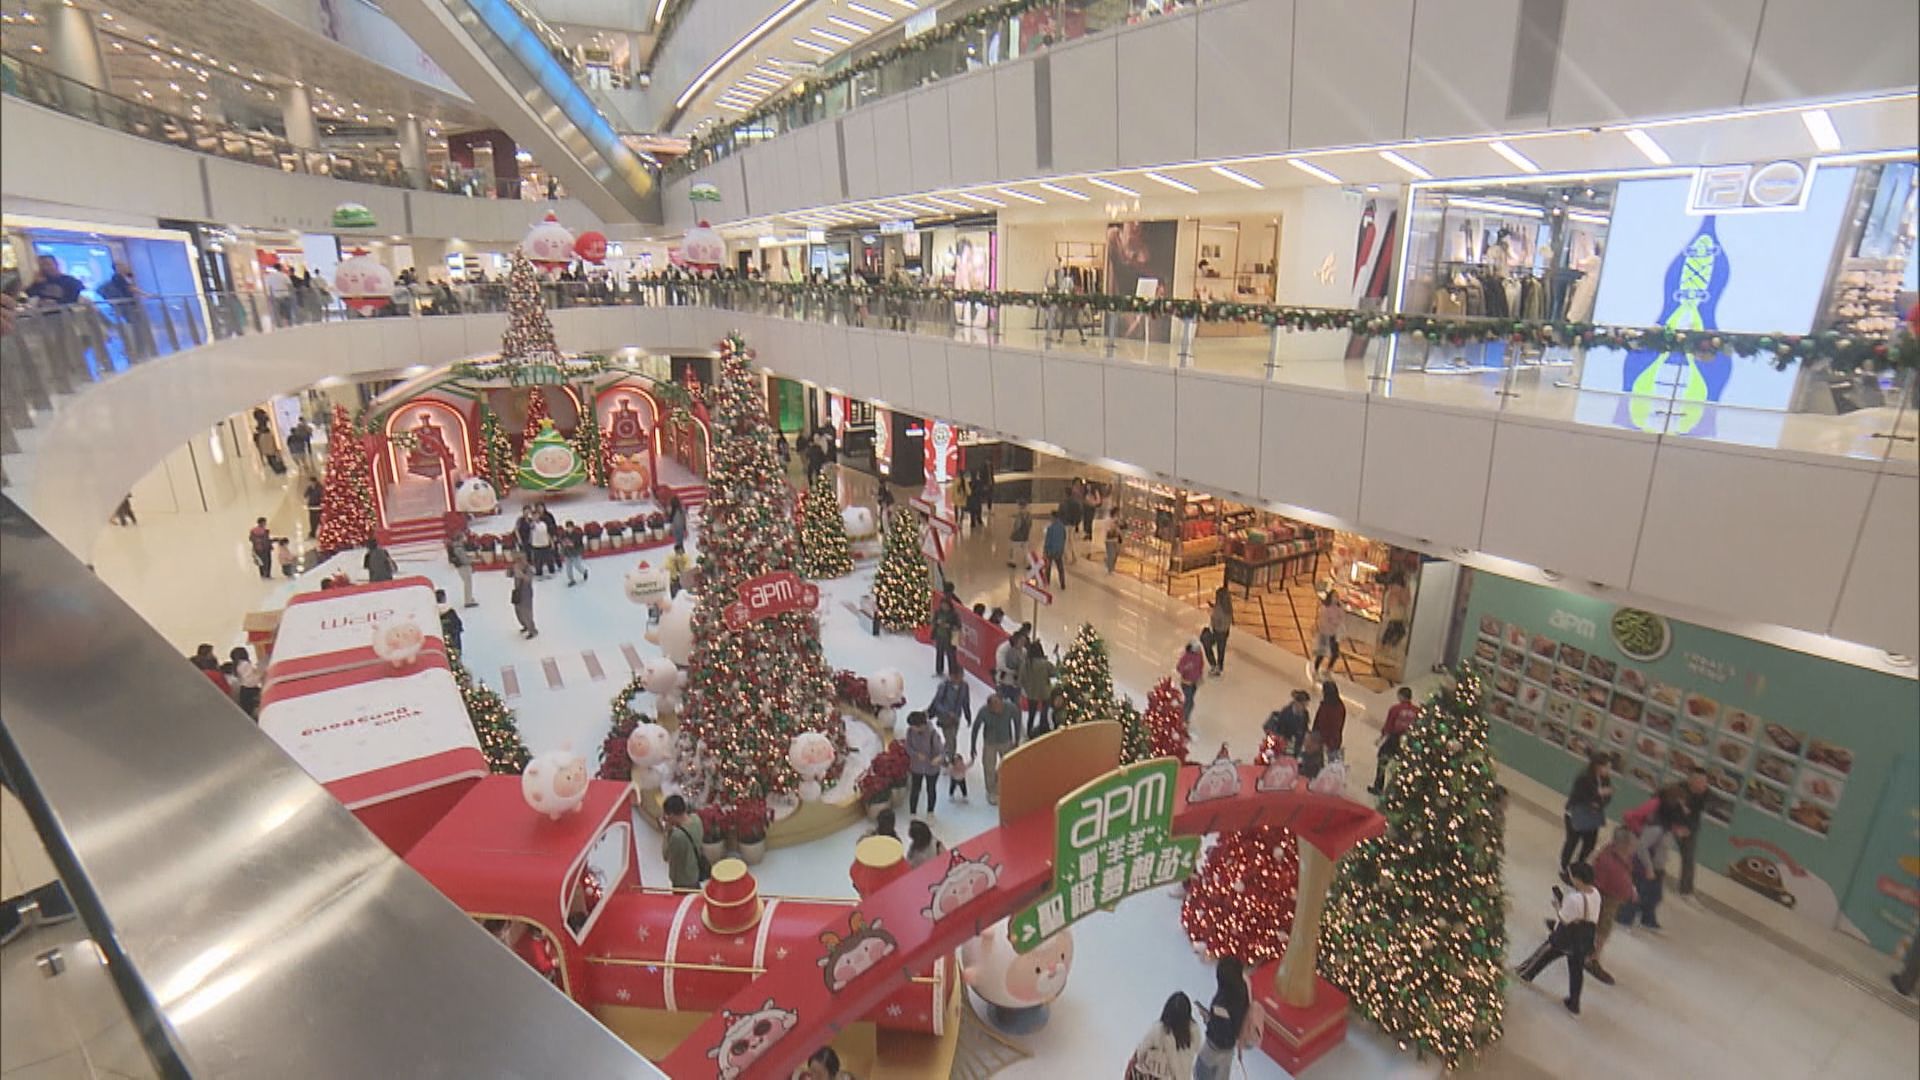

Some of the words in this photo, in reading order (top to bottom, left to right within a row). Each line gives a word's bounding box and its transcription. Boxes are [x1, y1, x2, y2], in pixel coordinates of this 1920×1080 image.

[751, 580, 793, 609] apm
[1549, 608, 1597, 641] apm
[1070, 771, 1167, 849] apm
